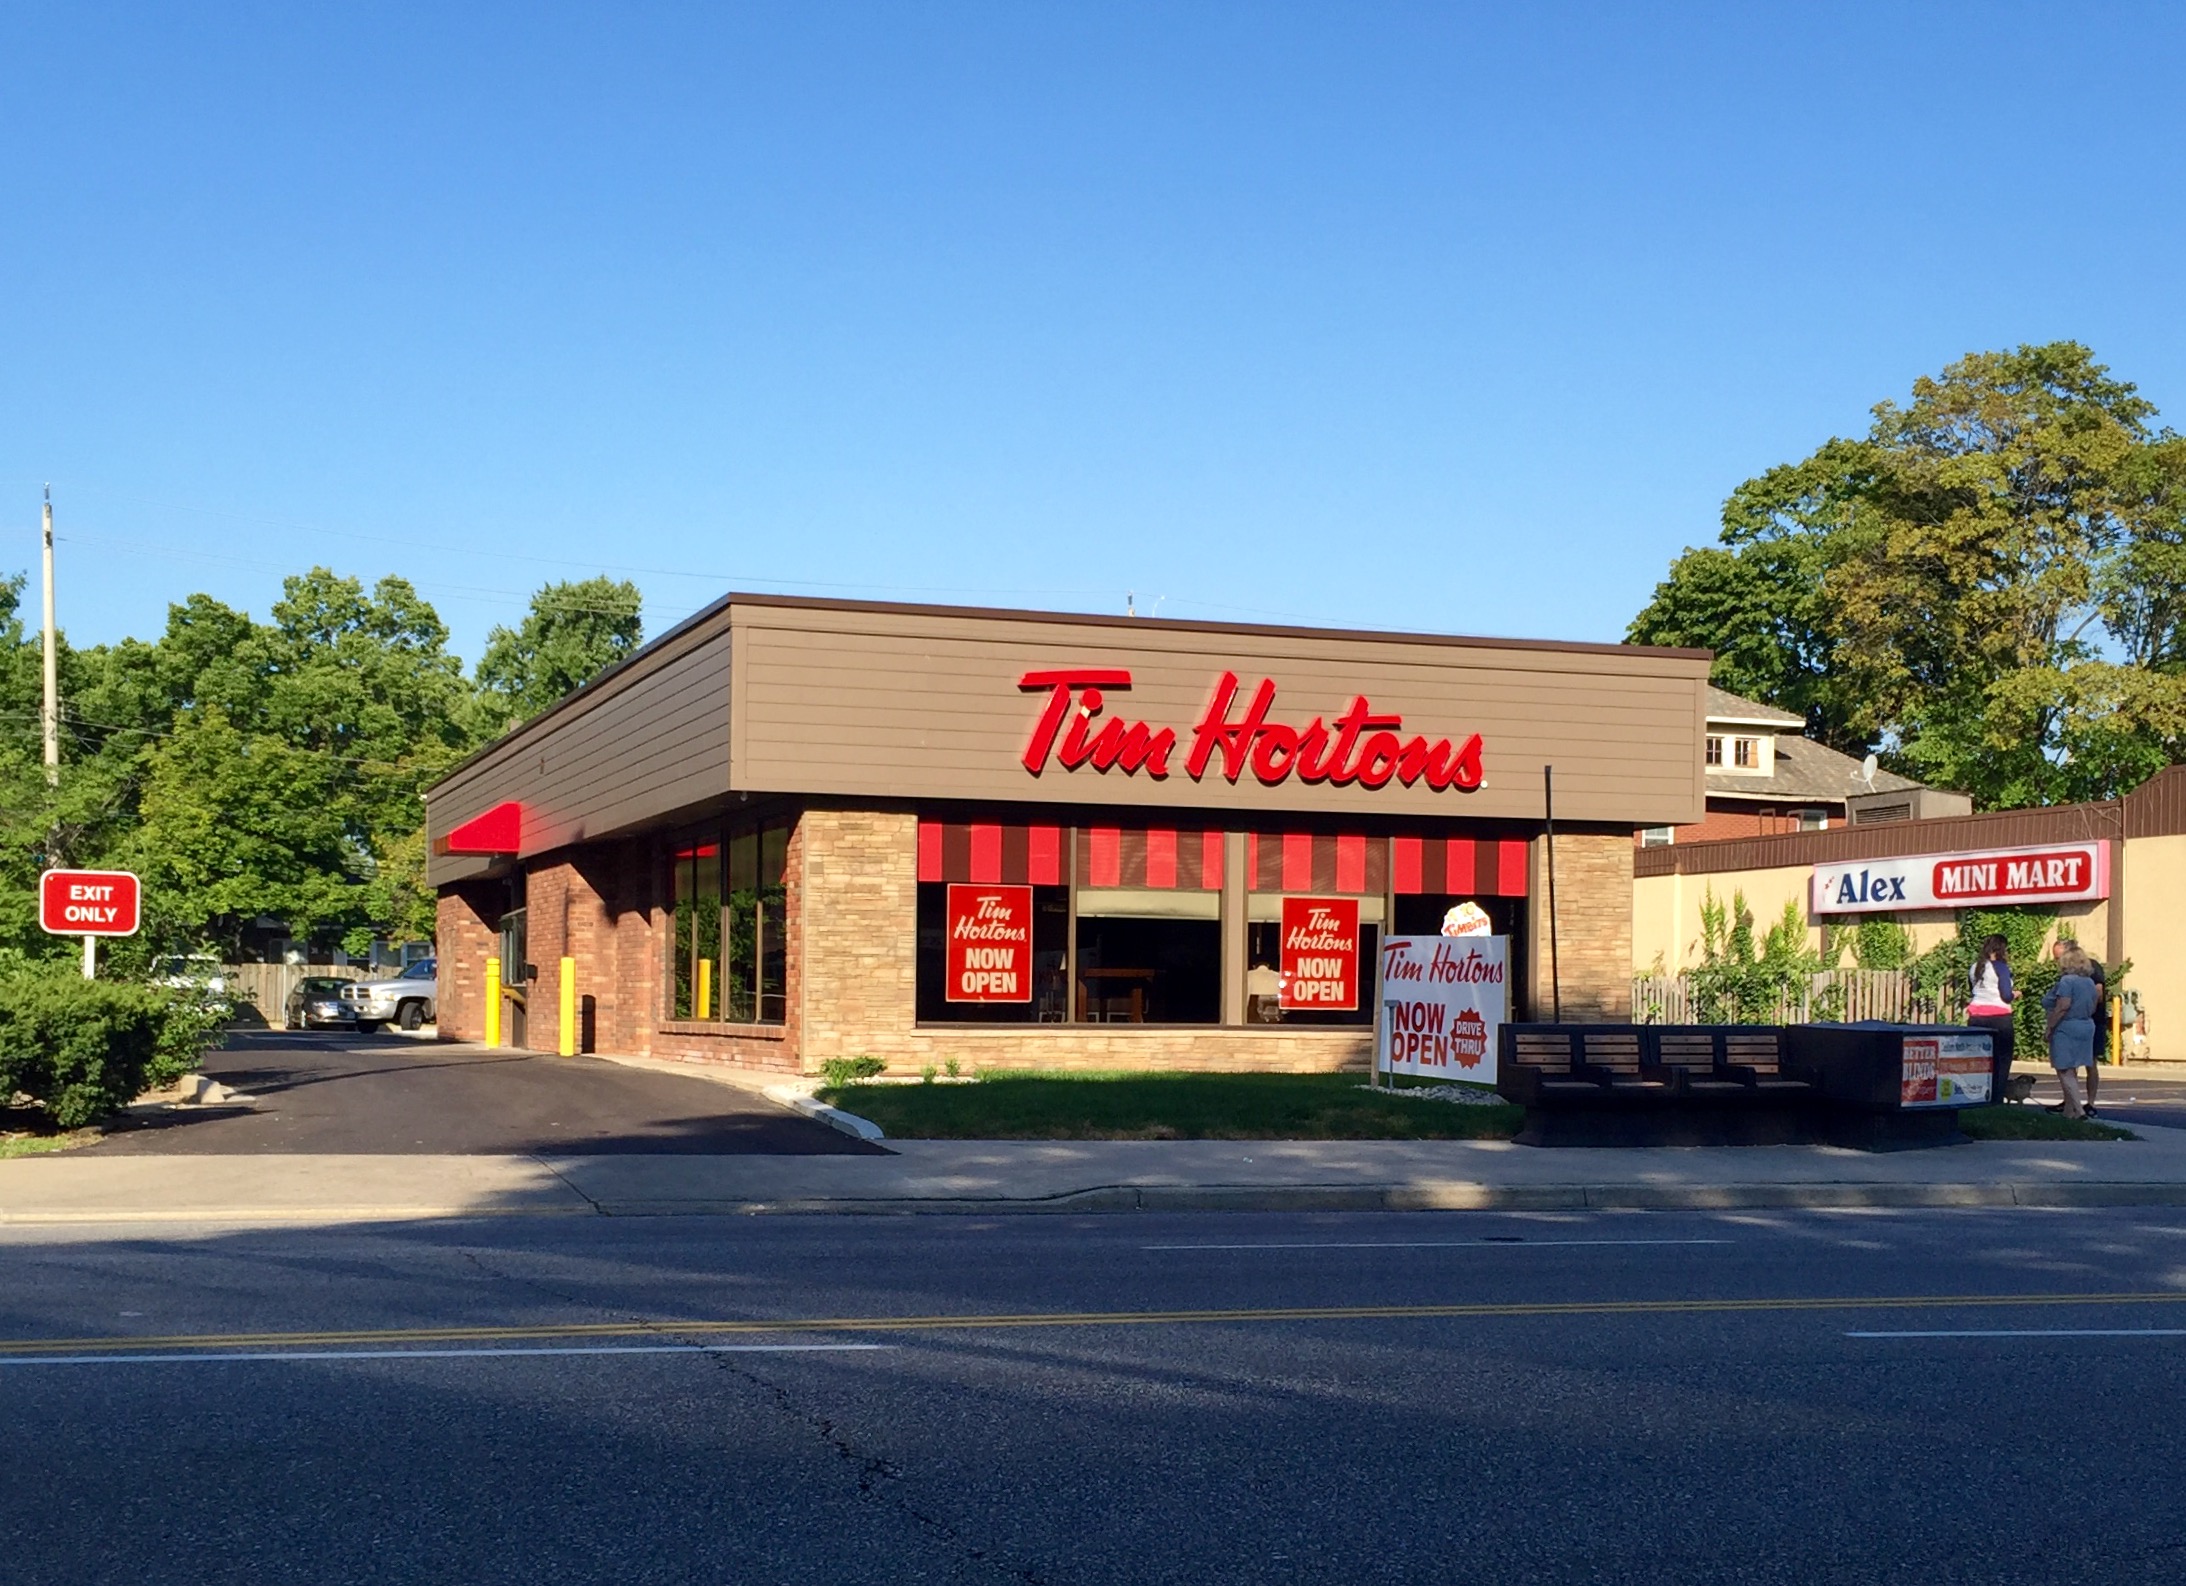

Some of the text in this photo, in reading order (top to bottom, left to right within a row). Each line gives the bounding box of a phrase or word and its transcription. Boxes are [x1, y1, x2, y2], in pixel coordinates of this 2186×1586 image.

[1017, 670, 1486, 790] Tim Hortons
[1836, 857, 2083, 904] Alex MINI MART
[70, 885, 114, 902] EXIT
[64, 905, 118, 923] ONLY
[976, 896, 1013, 921] Tim
[1307, 908, 1341, 932] Tim
[953, 914, 1027, 942] Hortons
[1286, 926, 1353, 951] Hortons
[965, 947, 1015, 970] NOW
[1297, 957, 1343, 979] NOW
[1384, 941, 1504, 985] Tim Hortons
[961, 971, 1018, 994] OPEN
[1292, 980, 1345, 1002] OPEN
[1395, 1001, 1446, 1035] NOW
[1456, 1021, 1482, 1036] DRIVE
[1391, 1033, 1449, 1067] OPEN
[1455, 1037, 1481, 1055] THRU
